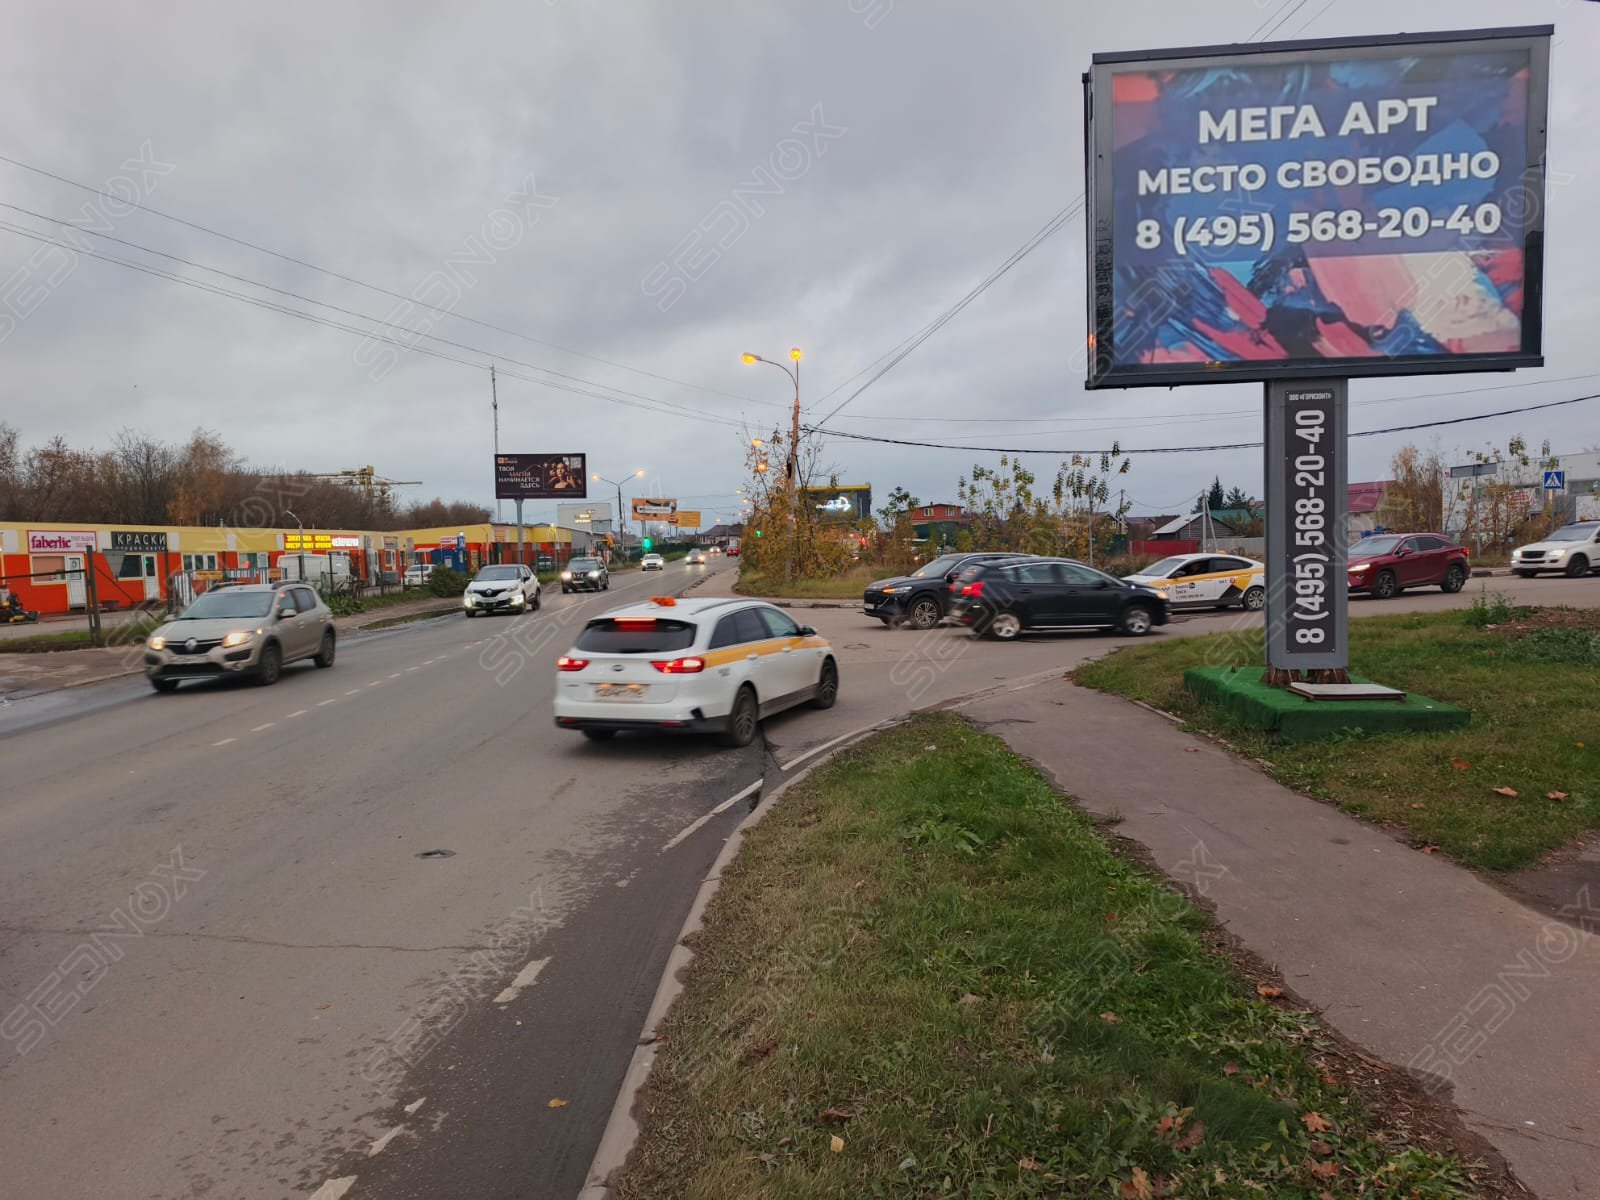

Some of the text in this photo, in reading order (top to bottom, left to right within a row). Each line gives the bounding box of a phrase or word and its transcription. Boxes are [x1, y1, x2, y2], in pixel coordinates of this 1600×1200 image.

[1199, 97, 1438, 144] МЕГА АРТ
[1138, 151, 1500, 196] МЕСТО СВОБОДНО
[1135, 203, 1501, 255] 8 (495) 568-20-40
[31, 535, 71, 549] faberlic
[117, 534, 167, 546] КРАСКИ
[1293, 409, 1329, 644] 8 (495) 568-20-40
